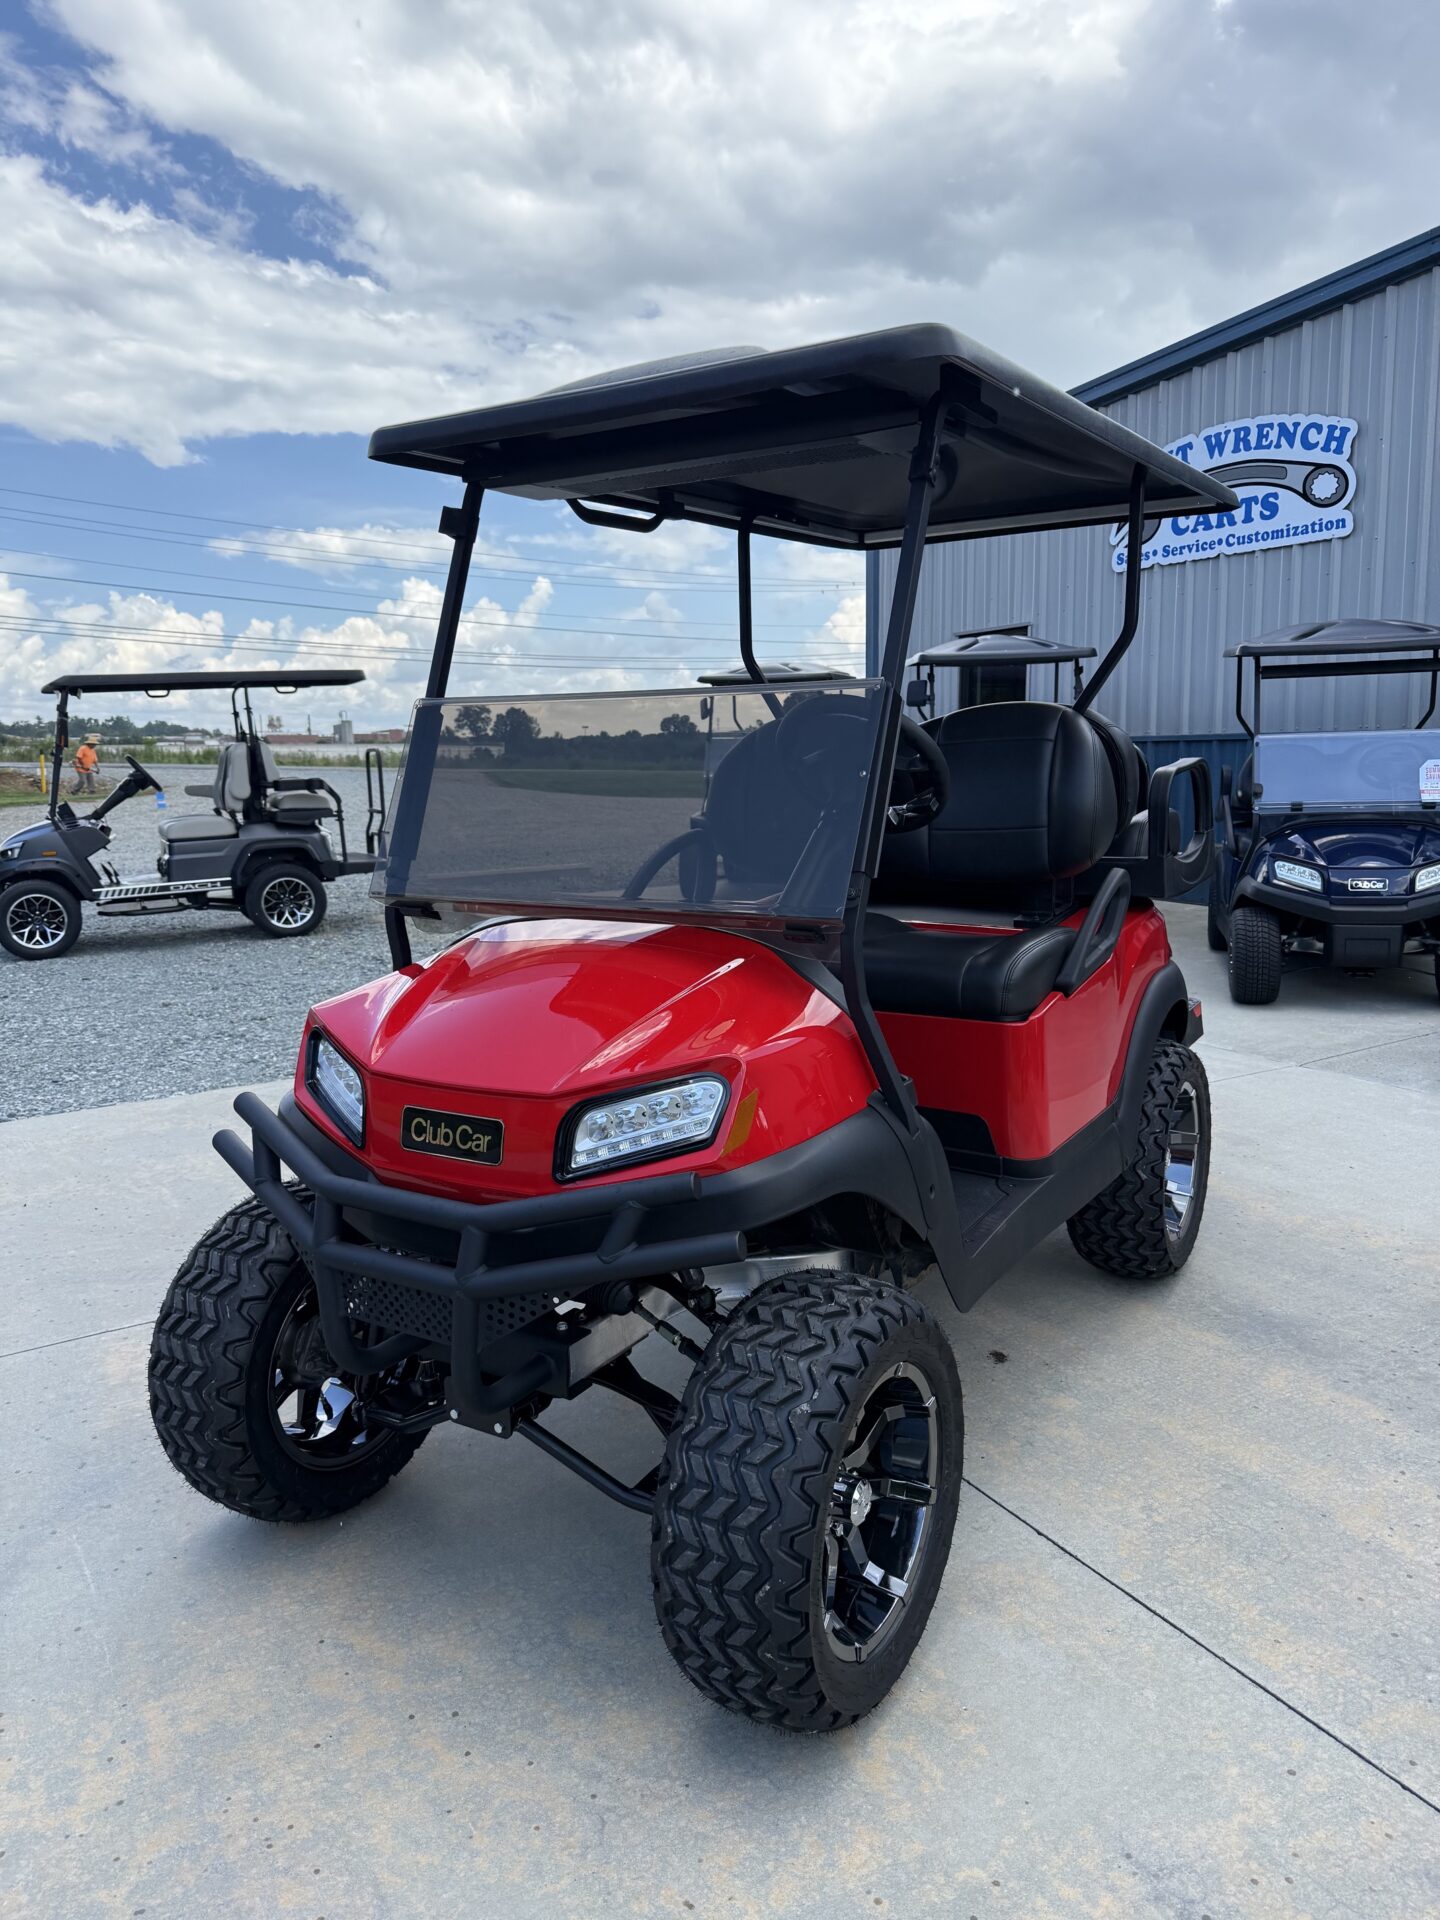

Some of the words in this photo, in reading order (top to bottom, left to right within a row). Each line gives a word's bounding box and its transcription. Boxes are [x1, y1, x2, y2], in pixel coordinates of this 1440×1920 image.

[1203, 421, 1350, 460] WRENCH
[1162, 540, 1216, 558] Service
[1225, 517, 1346, 547] Customization
[410, 1117, 453, 1147] Club
[455, 1124, 492, 1152] Car
